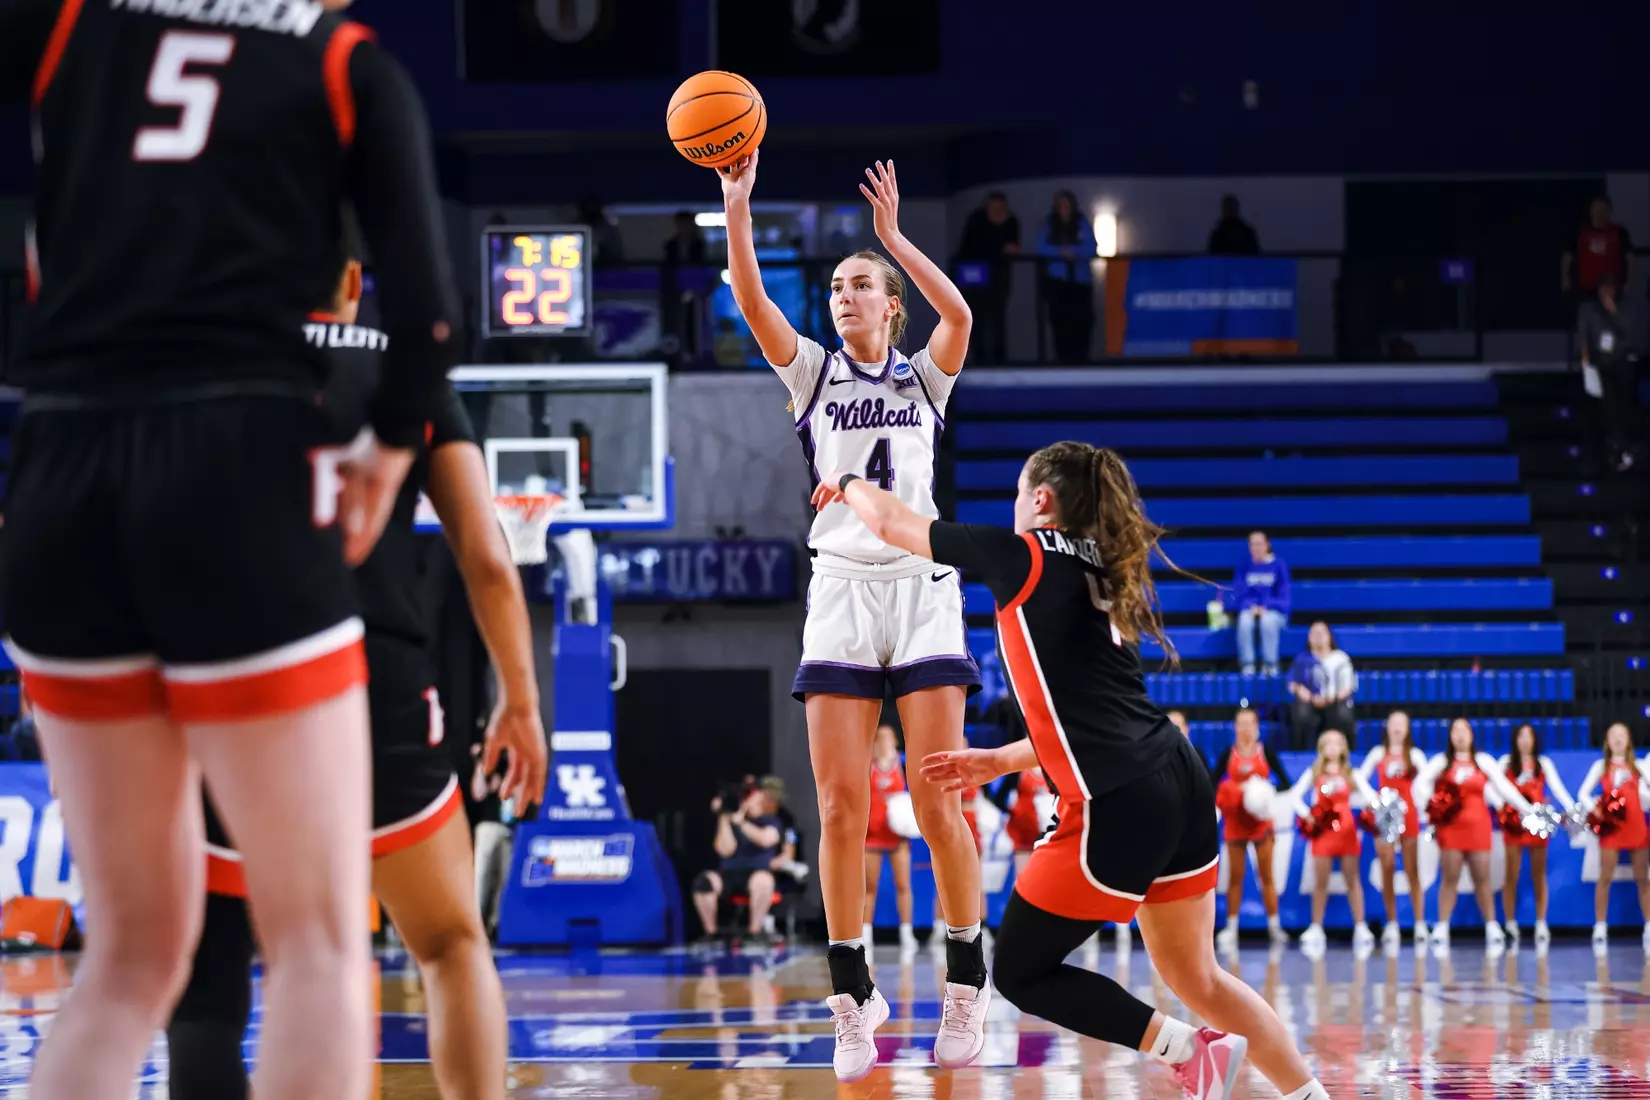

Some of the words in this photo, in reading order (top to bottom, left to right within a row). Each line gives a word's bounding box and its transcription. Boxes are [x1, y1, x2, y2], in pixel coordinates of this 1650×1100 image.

[132, 30, 235, 162] 5
[683, 131, 746, 159] Wilson
[513, 235, 581, 269] 7:15
[502, 268, 572, 325] 22
[825, 397, 922, 432] Wildcats
[865, 437, 895, 492] 4
